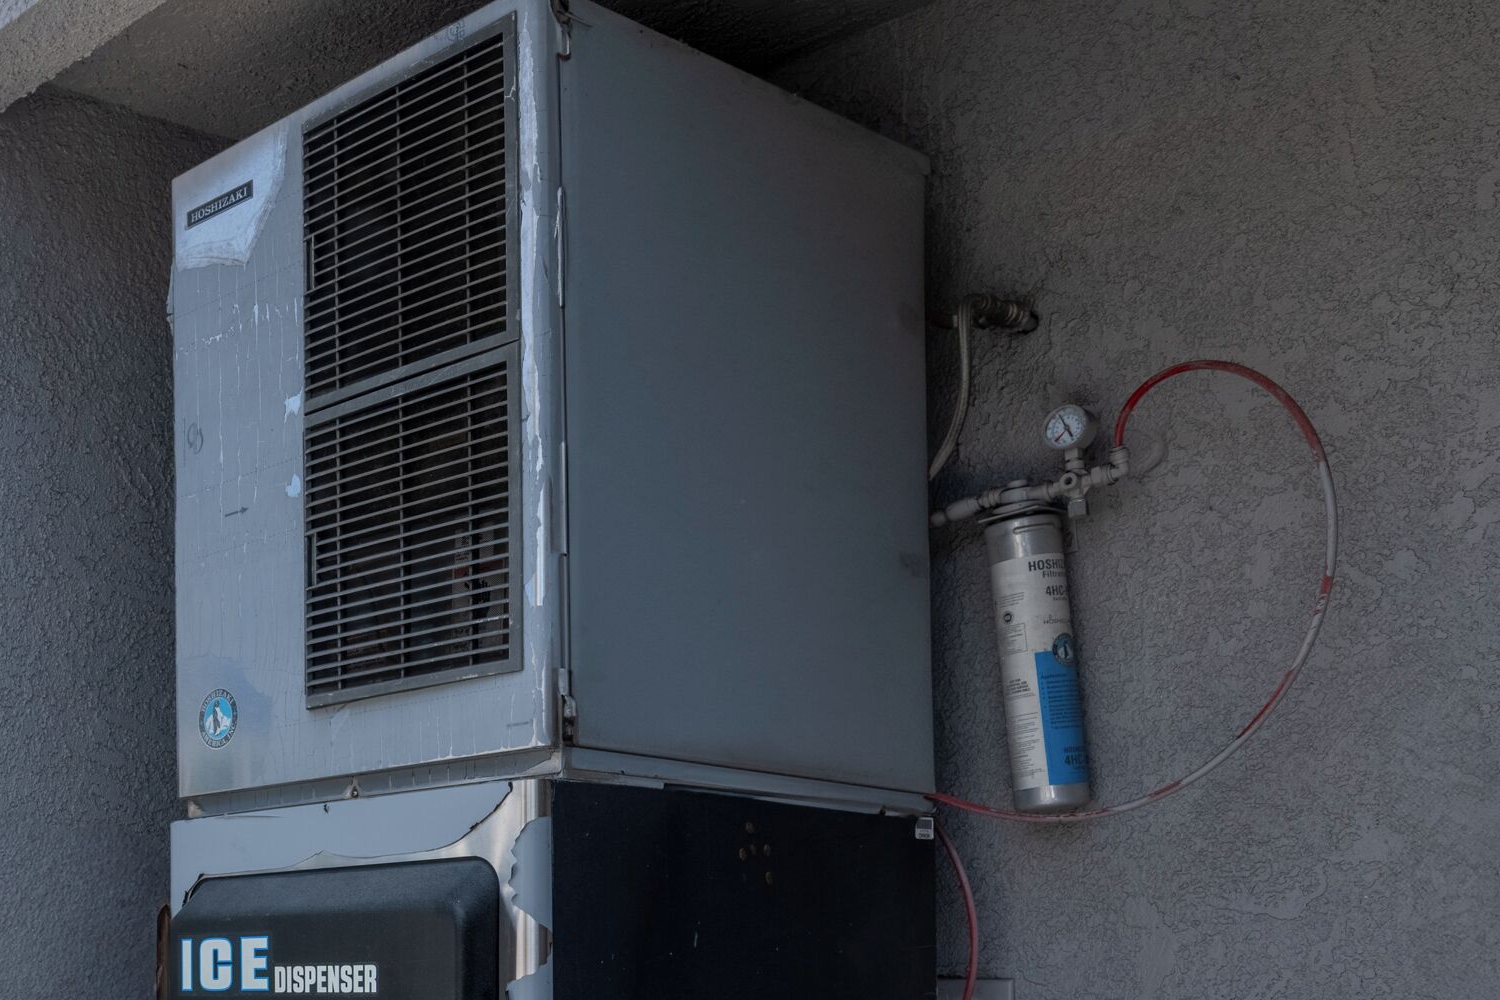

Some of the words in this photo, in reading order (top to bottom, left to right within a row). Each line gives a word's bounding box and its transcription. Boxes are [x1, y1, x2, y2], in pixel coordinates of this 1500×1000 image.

[191, 187, 248, 223] HOSHIZAKI
[180, 935, 270, 992] ICE
[274, 964, 378, 994] DISPENSER
